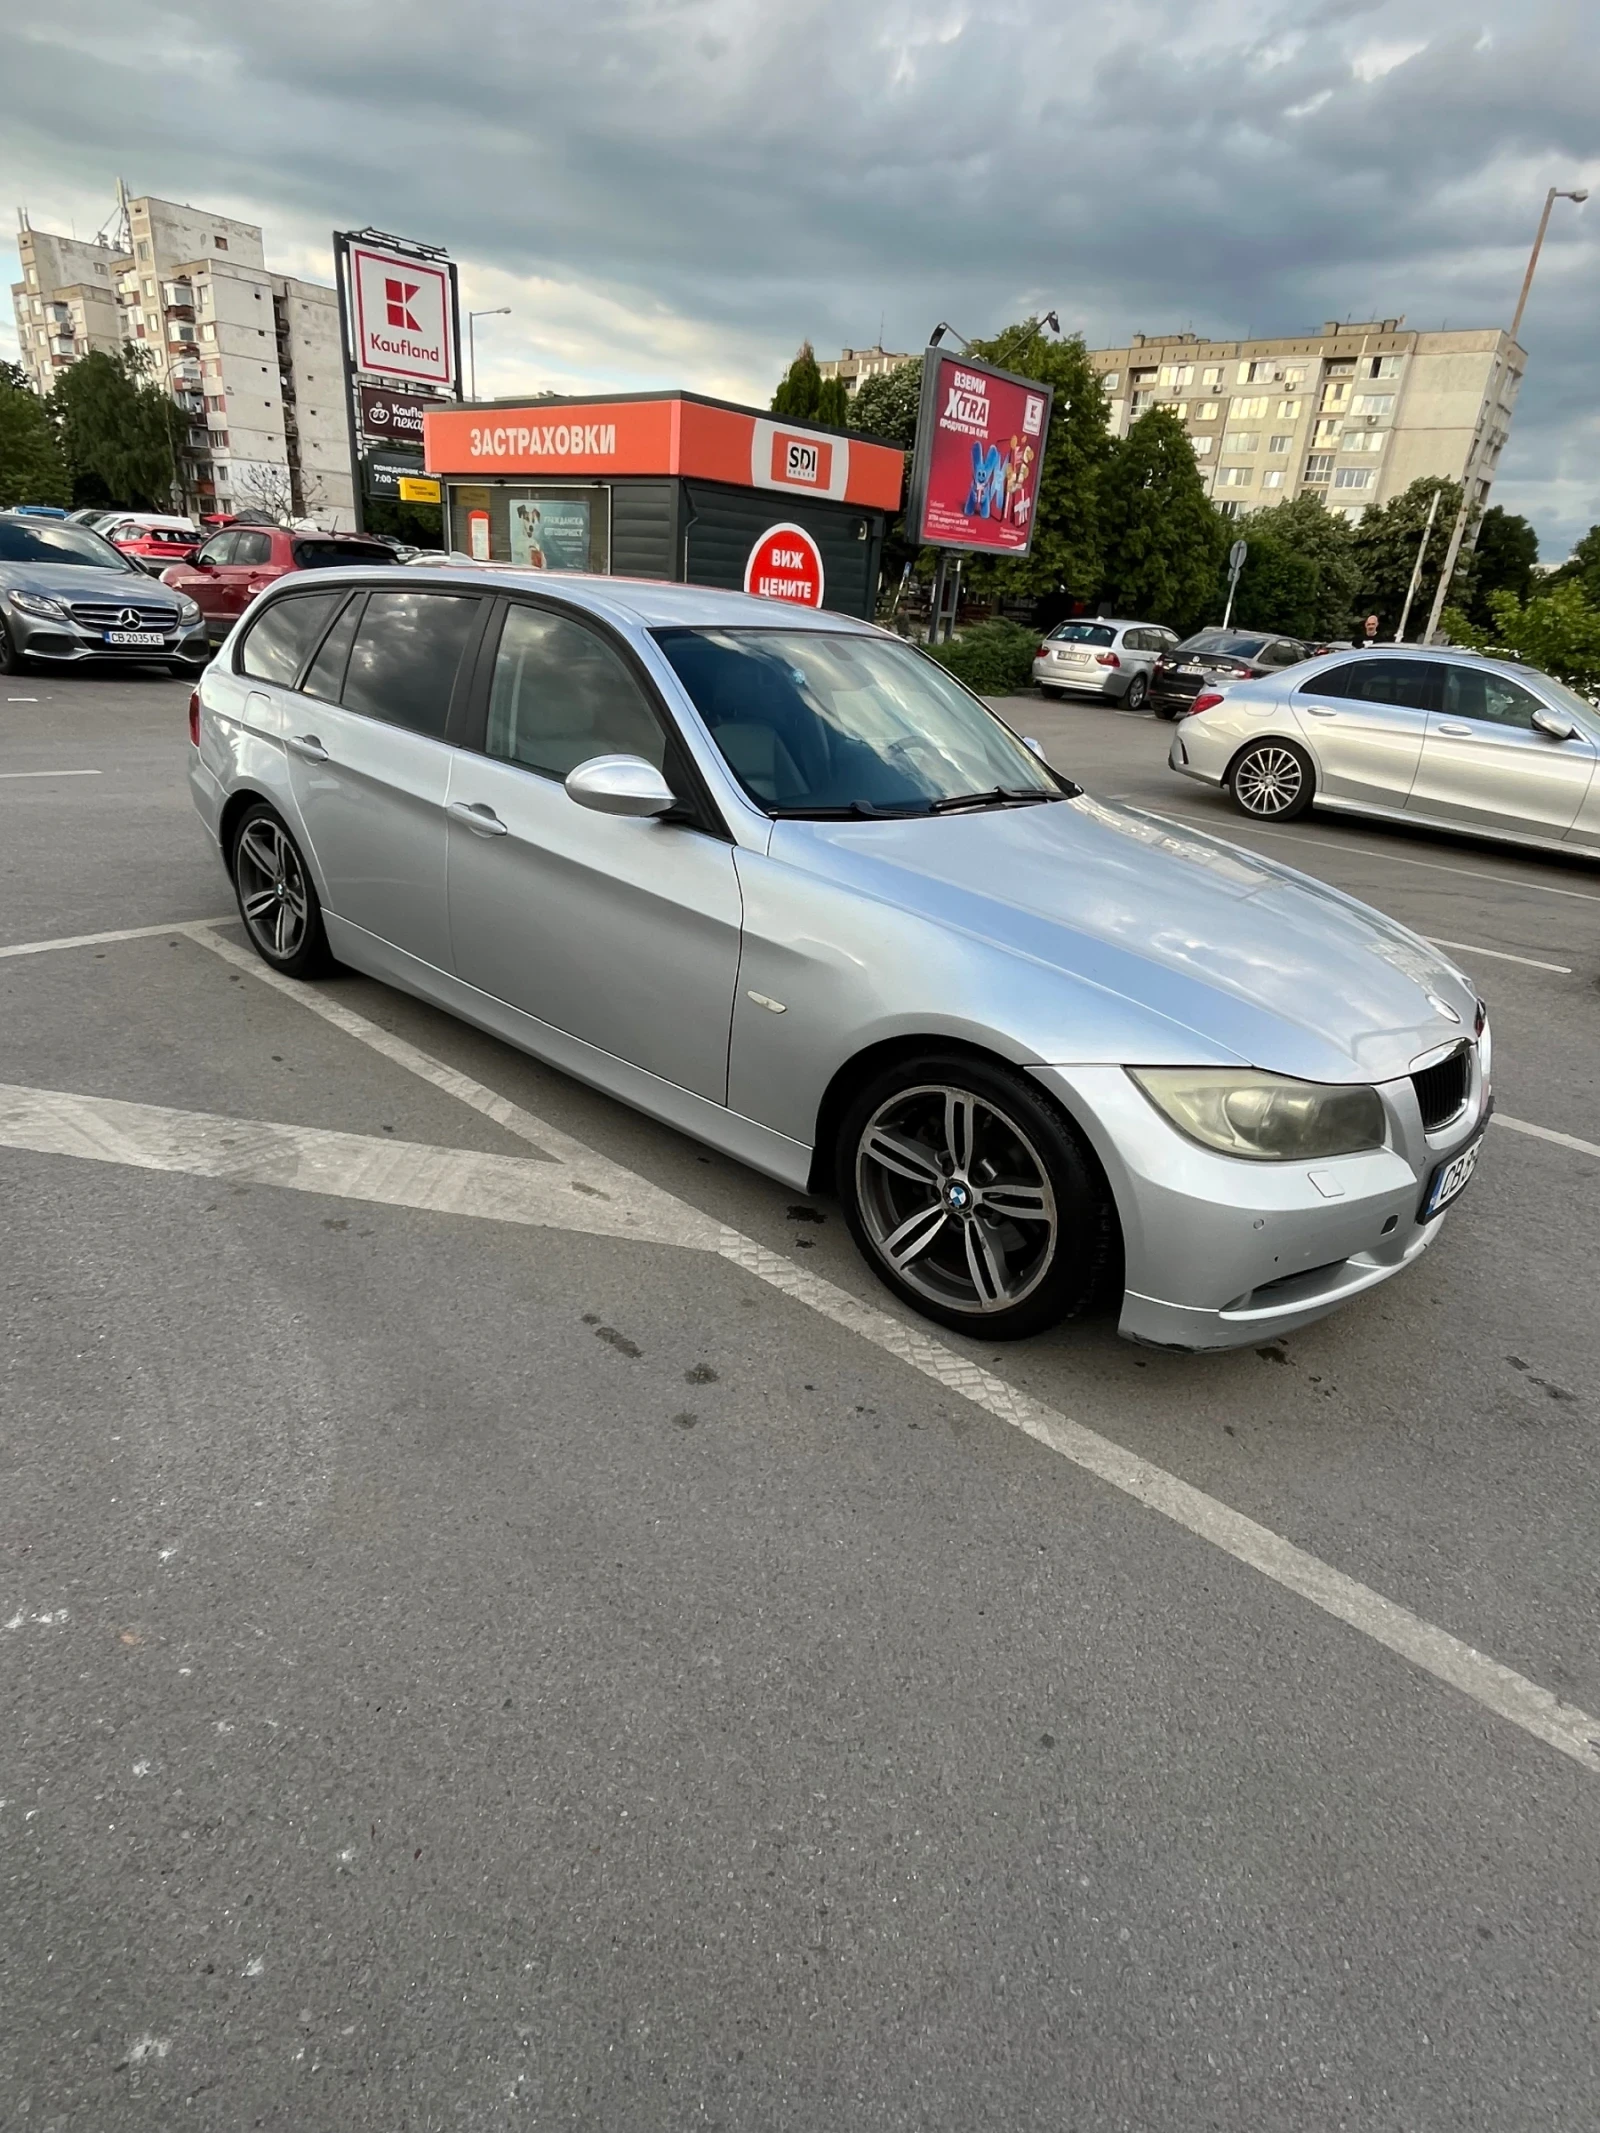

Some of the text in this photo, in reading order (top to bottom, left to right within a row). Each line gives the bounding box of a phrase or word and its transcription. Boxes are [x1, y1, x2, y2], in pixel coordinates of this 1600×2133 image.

[371, 333, 439, 362] Kaufland
[954, 370, 986, 395] ВЗЕМИ
[392, 403, 424, 418] Kaufla
[944, 388, 989, 425] XTRA
[470, 424, 616, 456] ЗАСТРАХОВКИ
[789, 446, 816, 471] SDI
[771, 549, 804, 569] ВИЖ
[759, 576, 812, 598] ЦЕНИТЕ
[111, 632, 163, 644] CB 2035 KE
